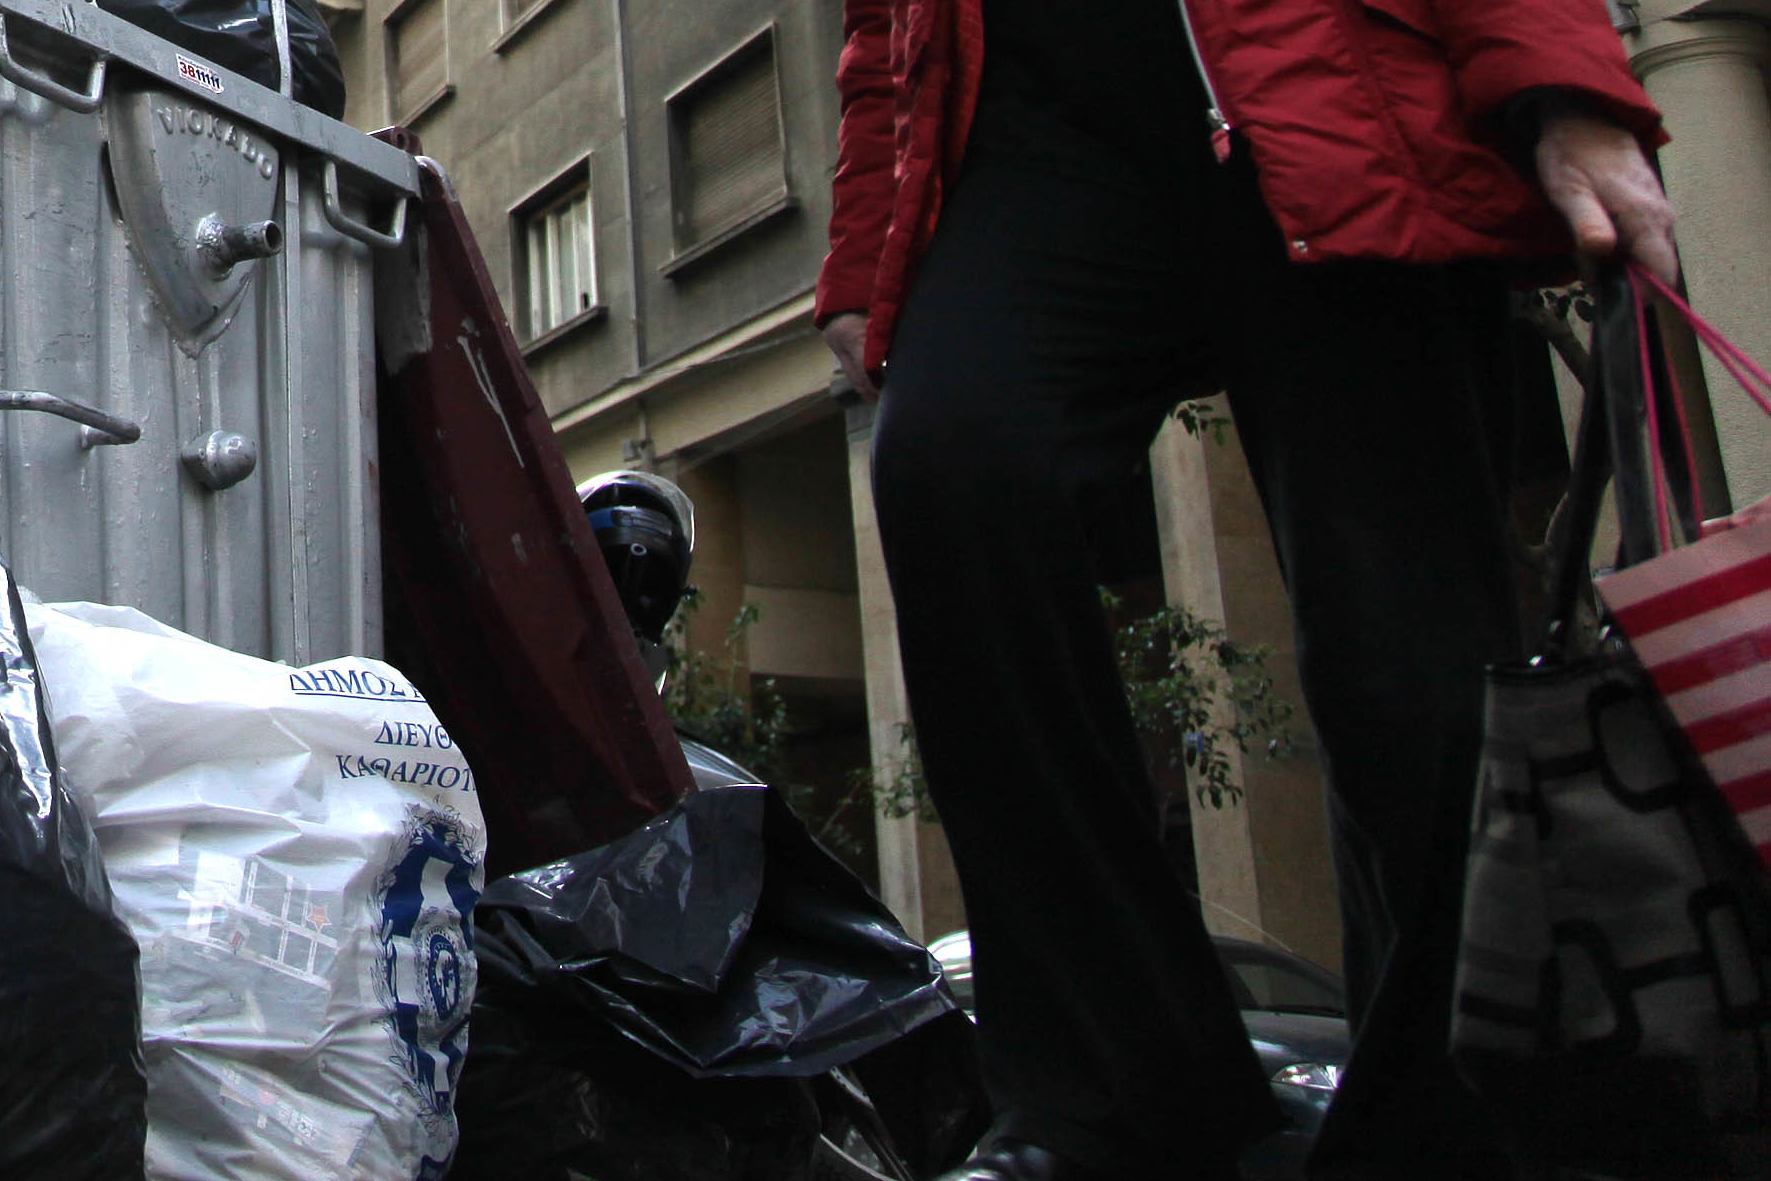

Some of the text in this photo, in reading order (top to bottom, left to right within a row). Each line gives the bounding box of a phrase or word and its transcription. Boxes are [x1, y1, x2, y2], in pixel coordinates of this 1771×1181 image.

[179, 61, 220, 89] 3811111
[289, 669, 406, 696] ΔΗΜΟΣ
[374, 721, 453, 749] ΔΙΕΥΘ
[336, 754, 476, 791] ΚΑΘΑΡΙΟΤ
